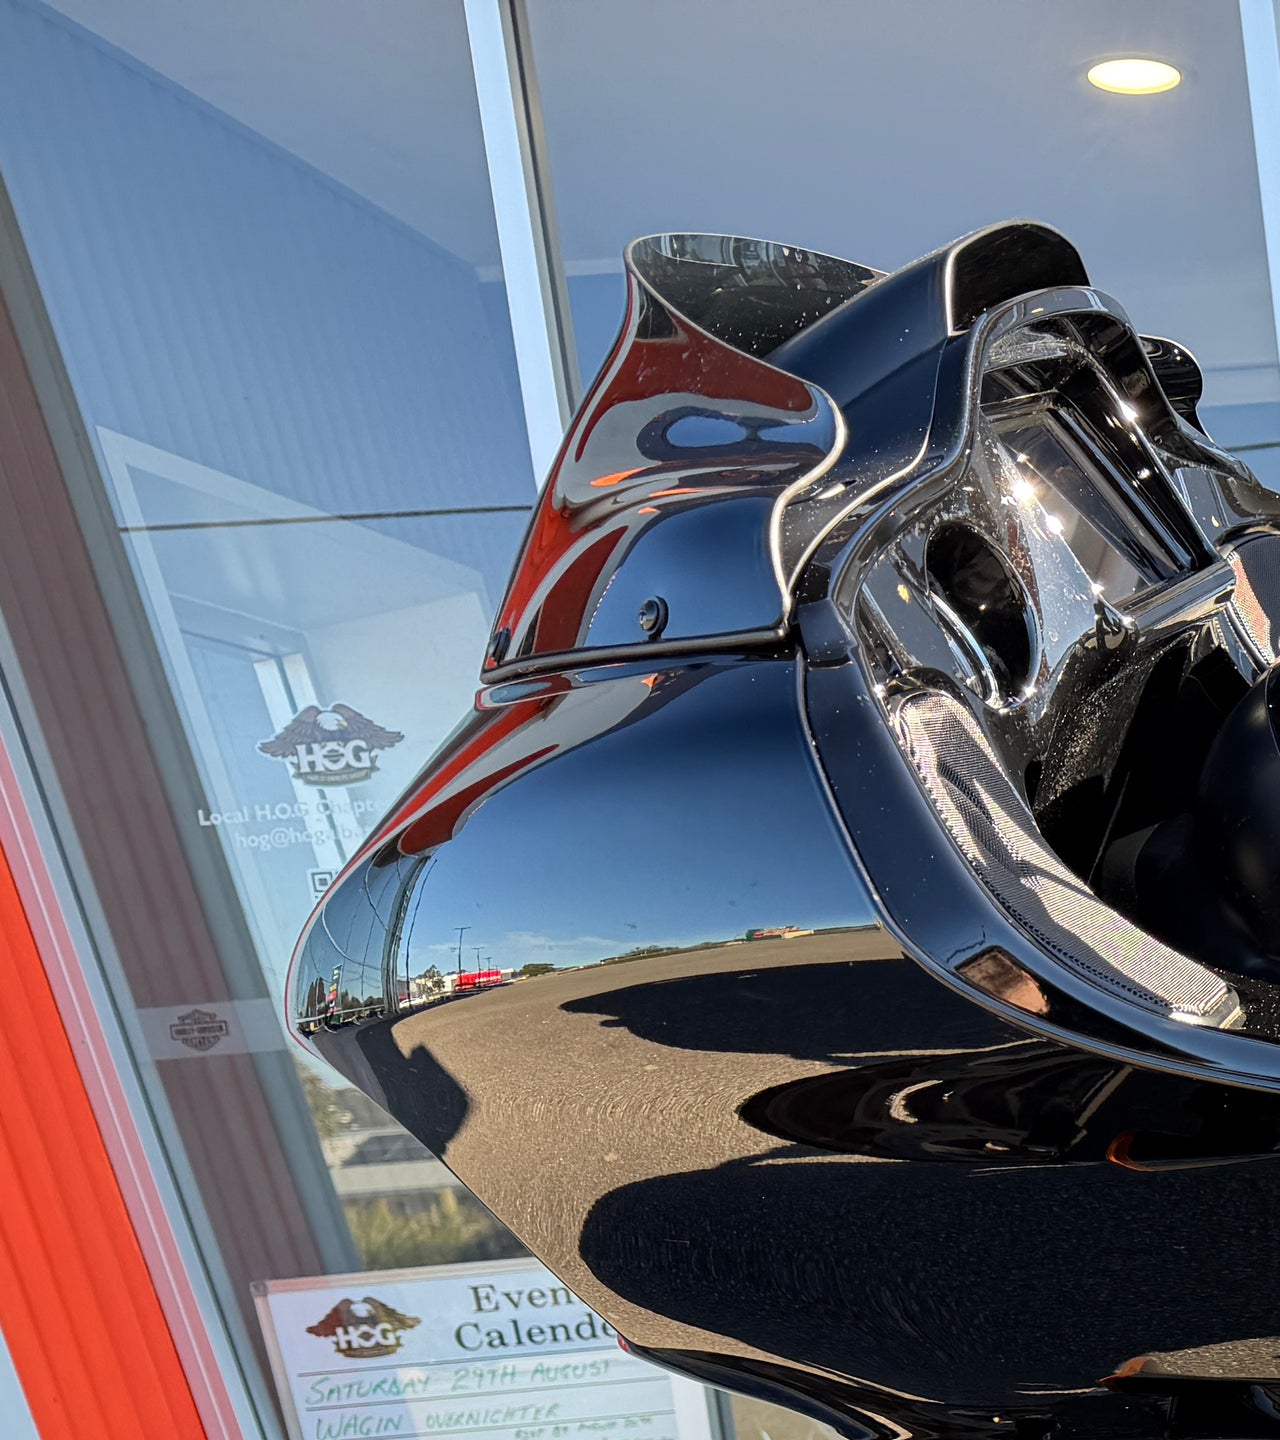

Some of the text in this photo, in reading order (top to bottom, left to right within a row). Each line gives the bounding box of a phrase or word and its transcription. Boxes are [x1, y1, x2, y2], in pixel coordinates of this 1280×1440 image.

[294, 738, 371, 772] HOG
[198, 807, 249, 827] Local
[335, 1322, 397, 1350] HOG
[306, 1359, 612, 1405] SATURDAY 29TH AUGUST
[316, 1414, 403, 1440] WAGIN
